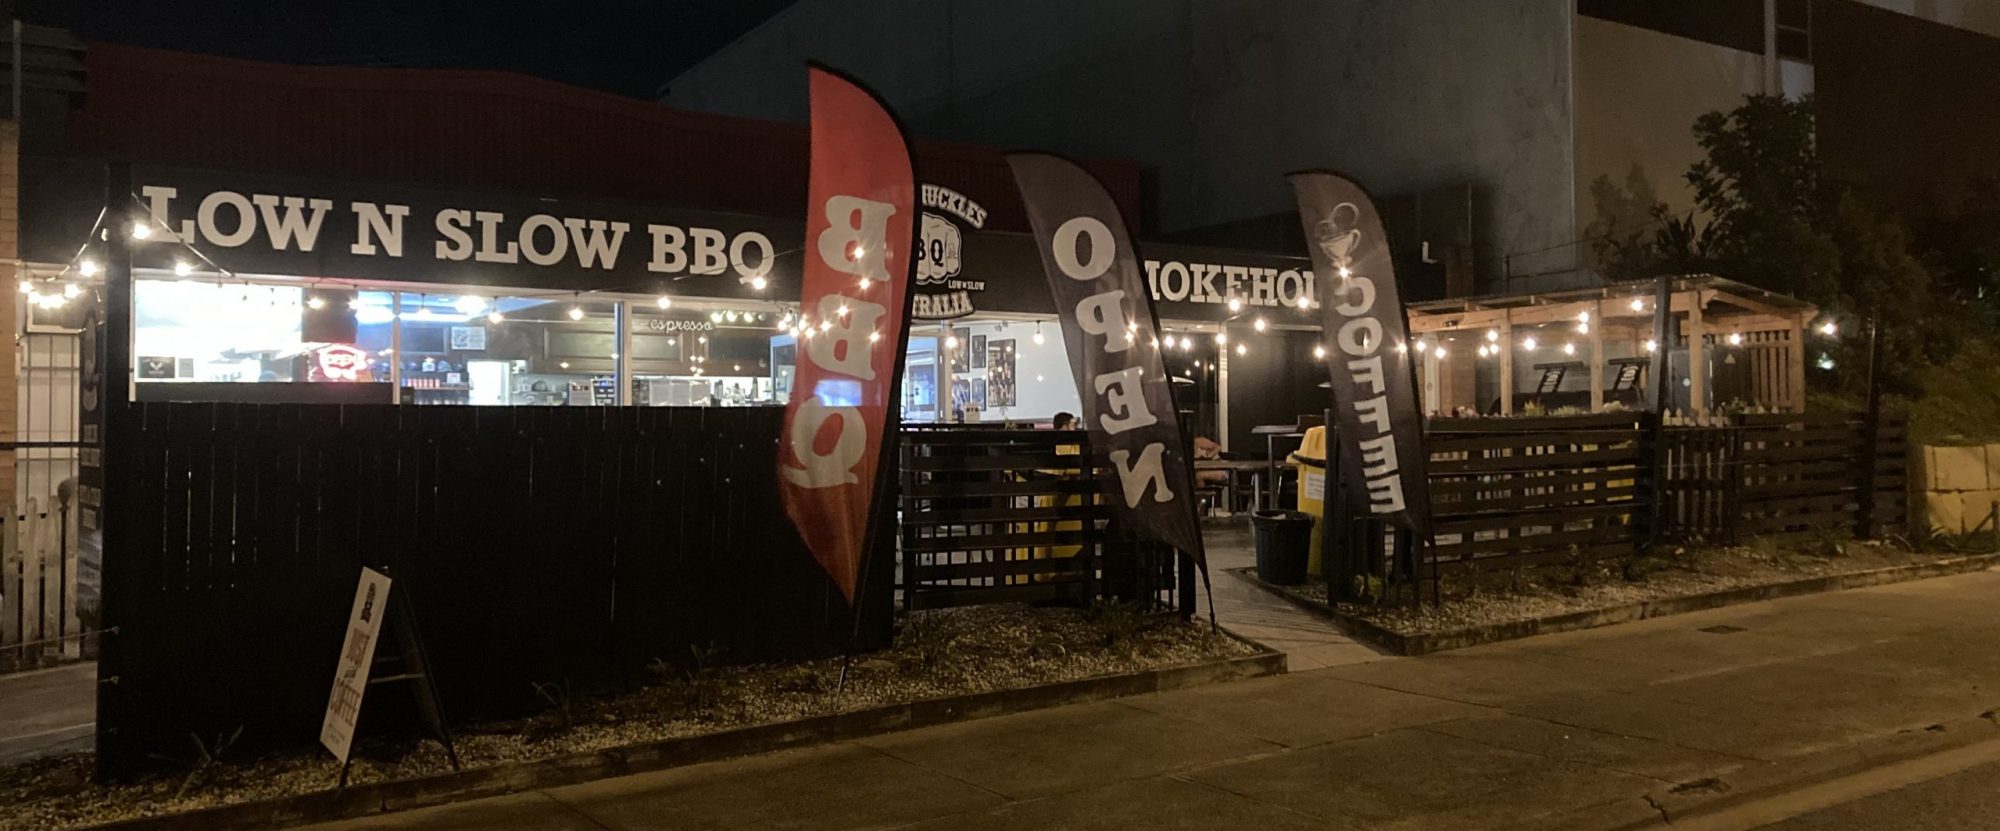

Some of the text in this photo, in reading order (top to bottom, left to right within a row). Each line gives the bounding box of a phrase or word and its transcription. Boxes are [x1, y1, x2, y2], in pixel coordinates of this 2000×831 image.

[921, 183, 988, 230] UCKLES
[142, 185, 775, 286] LOW N SLOW BBQ
[918, 239, 944, 267] BQ
[911, 290, 975, 317] TRALIA
[650, 319, 714, 334] espresso
